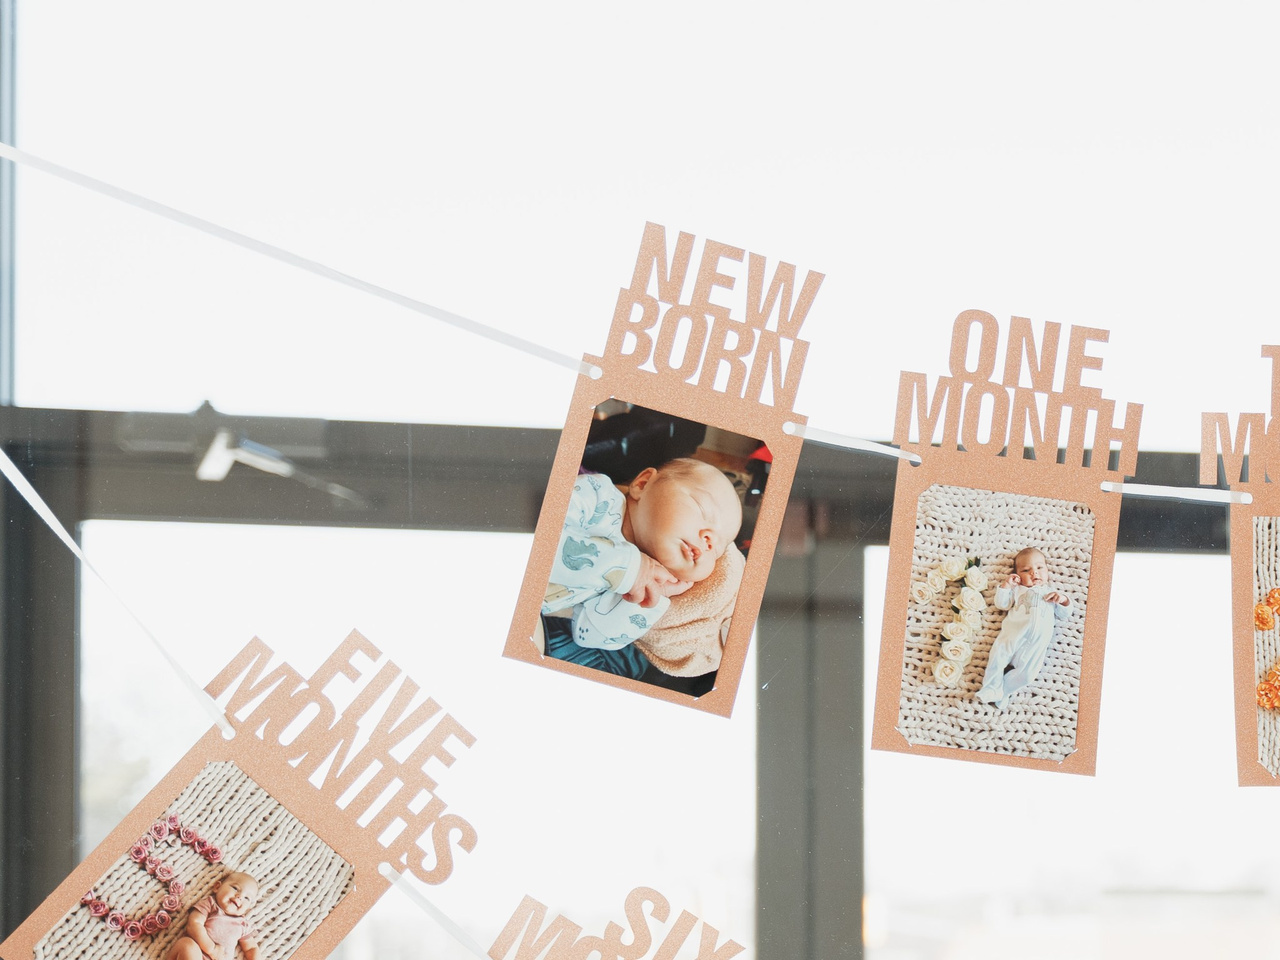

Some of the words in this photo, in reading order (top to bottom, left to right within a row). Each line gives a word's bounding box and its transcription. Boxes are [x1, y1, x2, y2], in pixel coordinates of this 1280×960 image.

[627, 220, 826, 339] NEW
[601, 287, 811, 412] BORN
[949, 309, 1110, 398] ONE
[892, 370, 1144, 477] MONTH
[203, 635, 478, 885] MONTHS
[308, 628, 477, 778] FIVE
